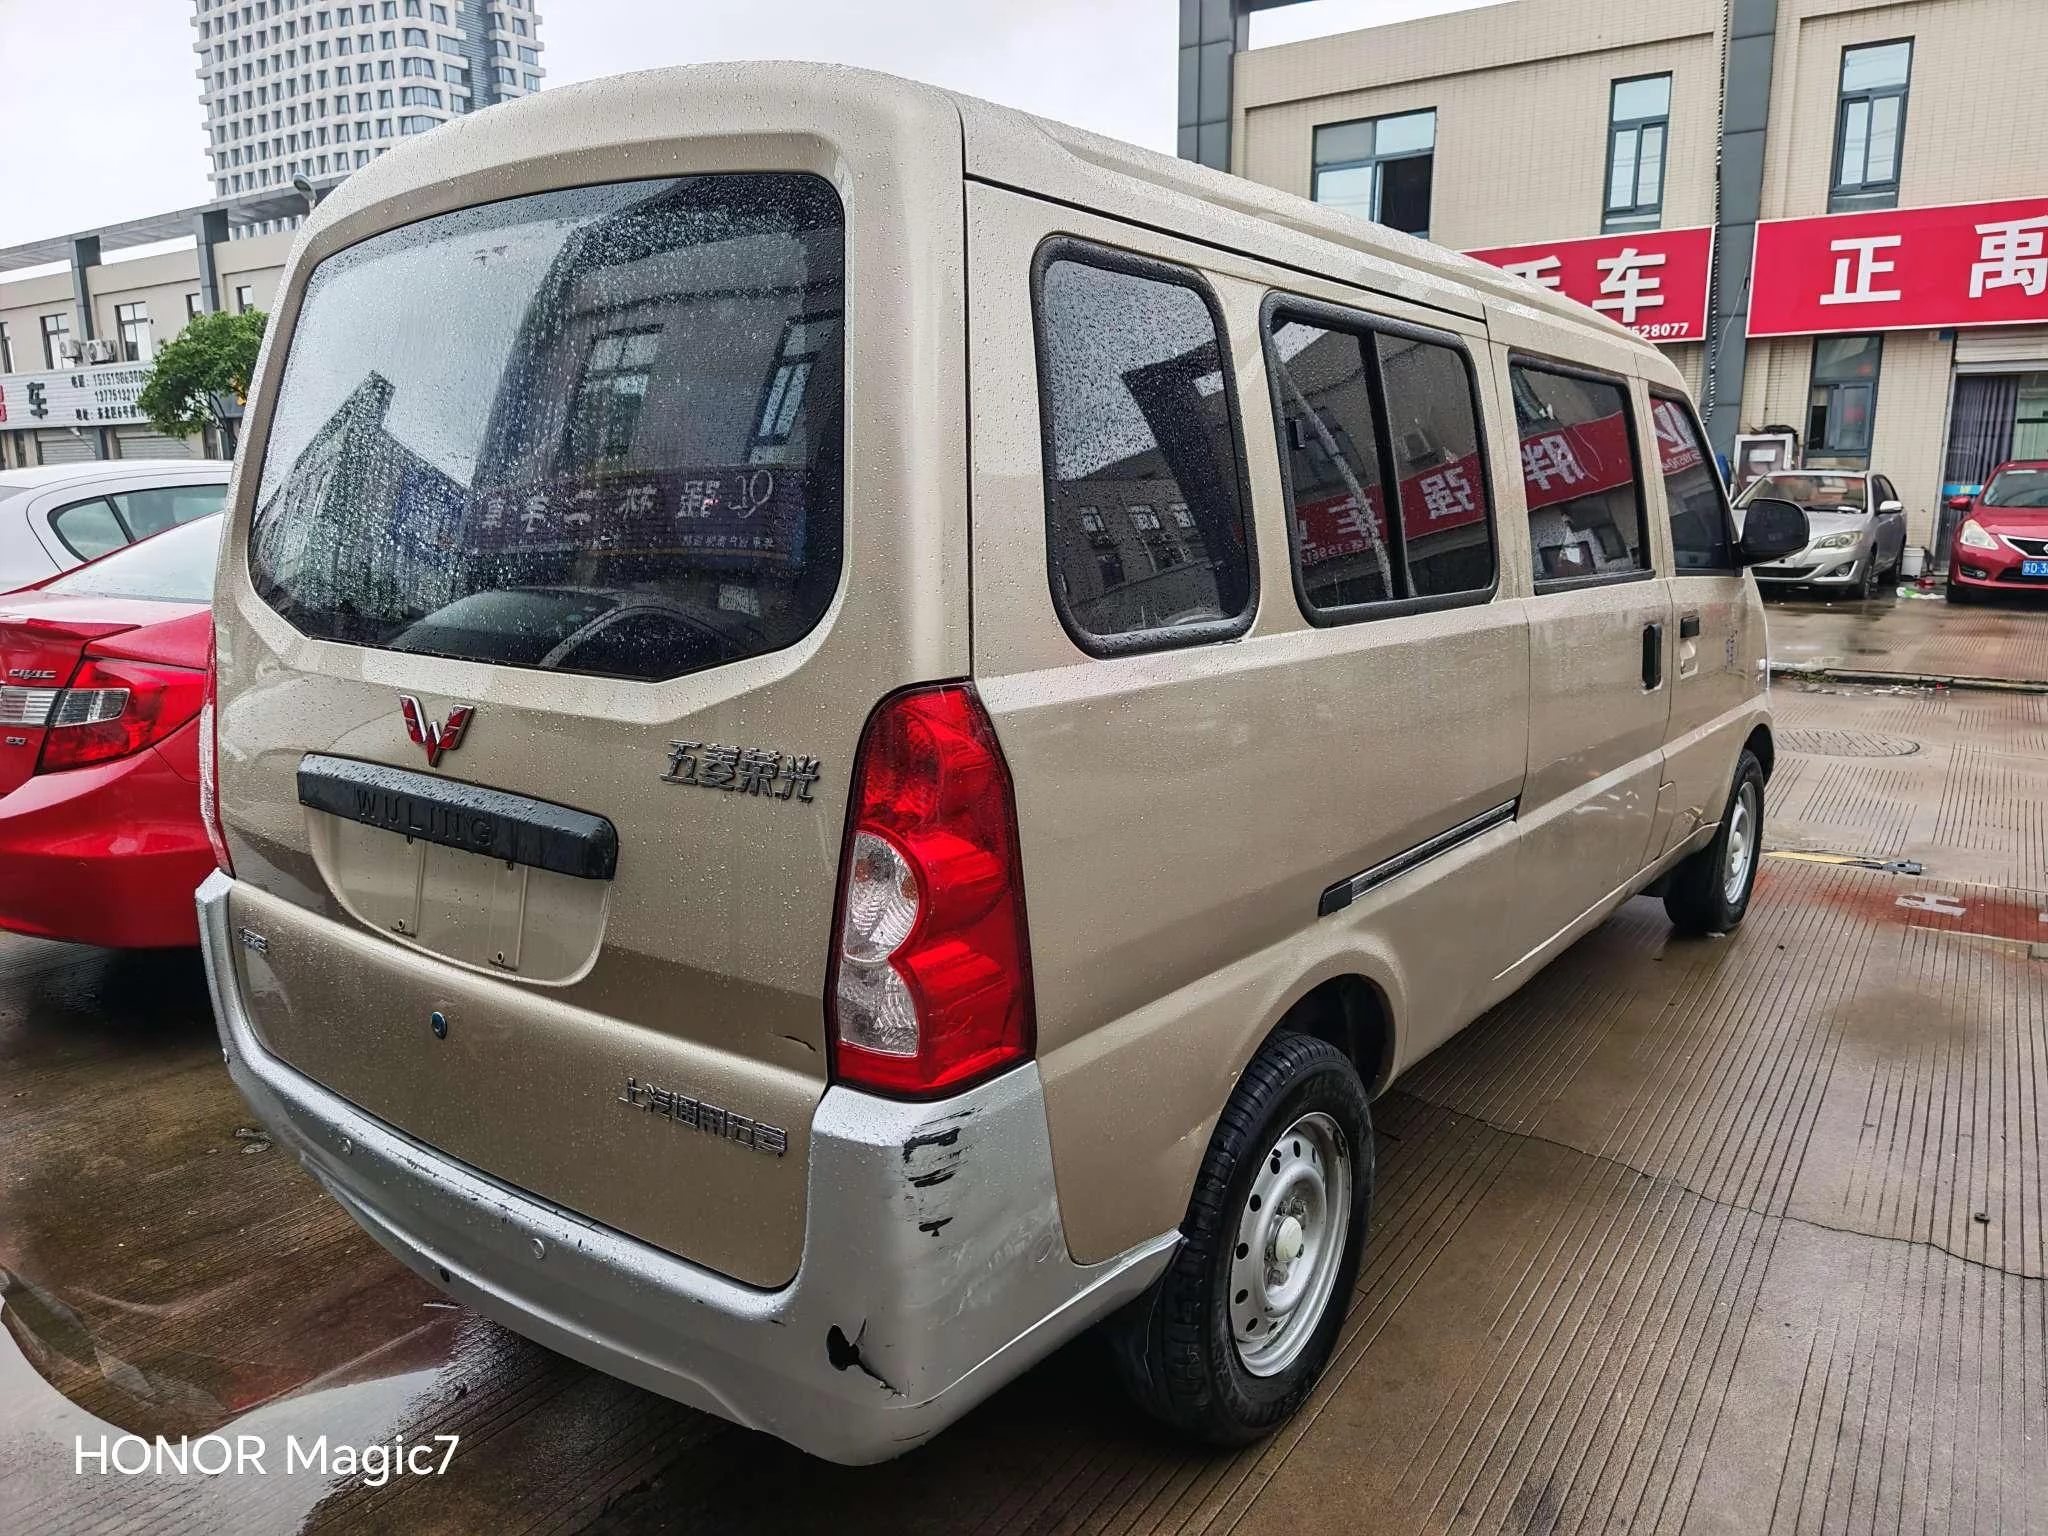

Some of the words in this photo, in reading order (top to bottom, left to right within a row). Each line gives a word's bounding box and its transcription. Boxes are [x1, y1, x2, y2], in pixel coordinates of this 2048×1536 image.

[660, 739, 820, 803] 五菱荣光
[355, 785, 494, 847] WULING
